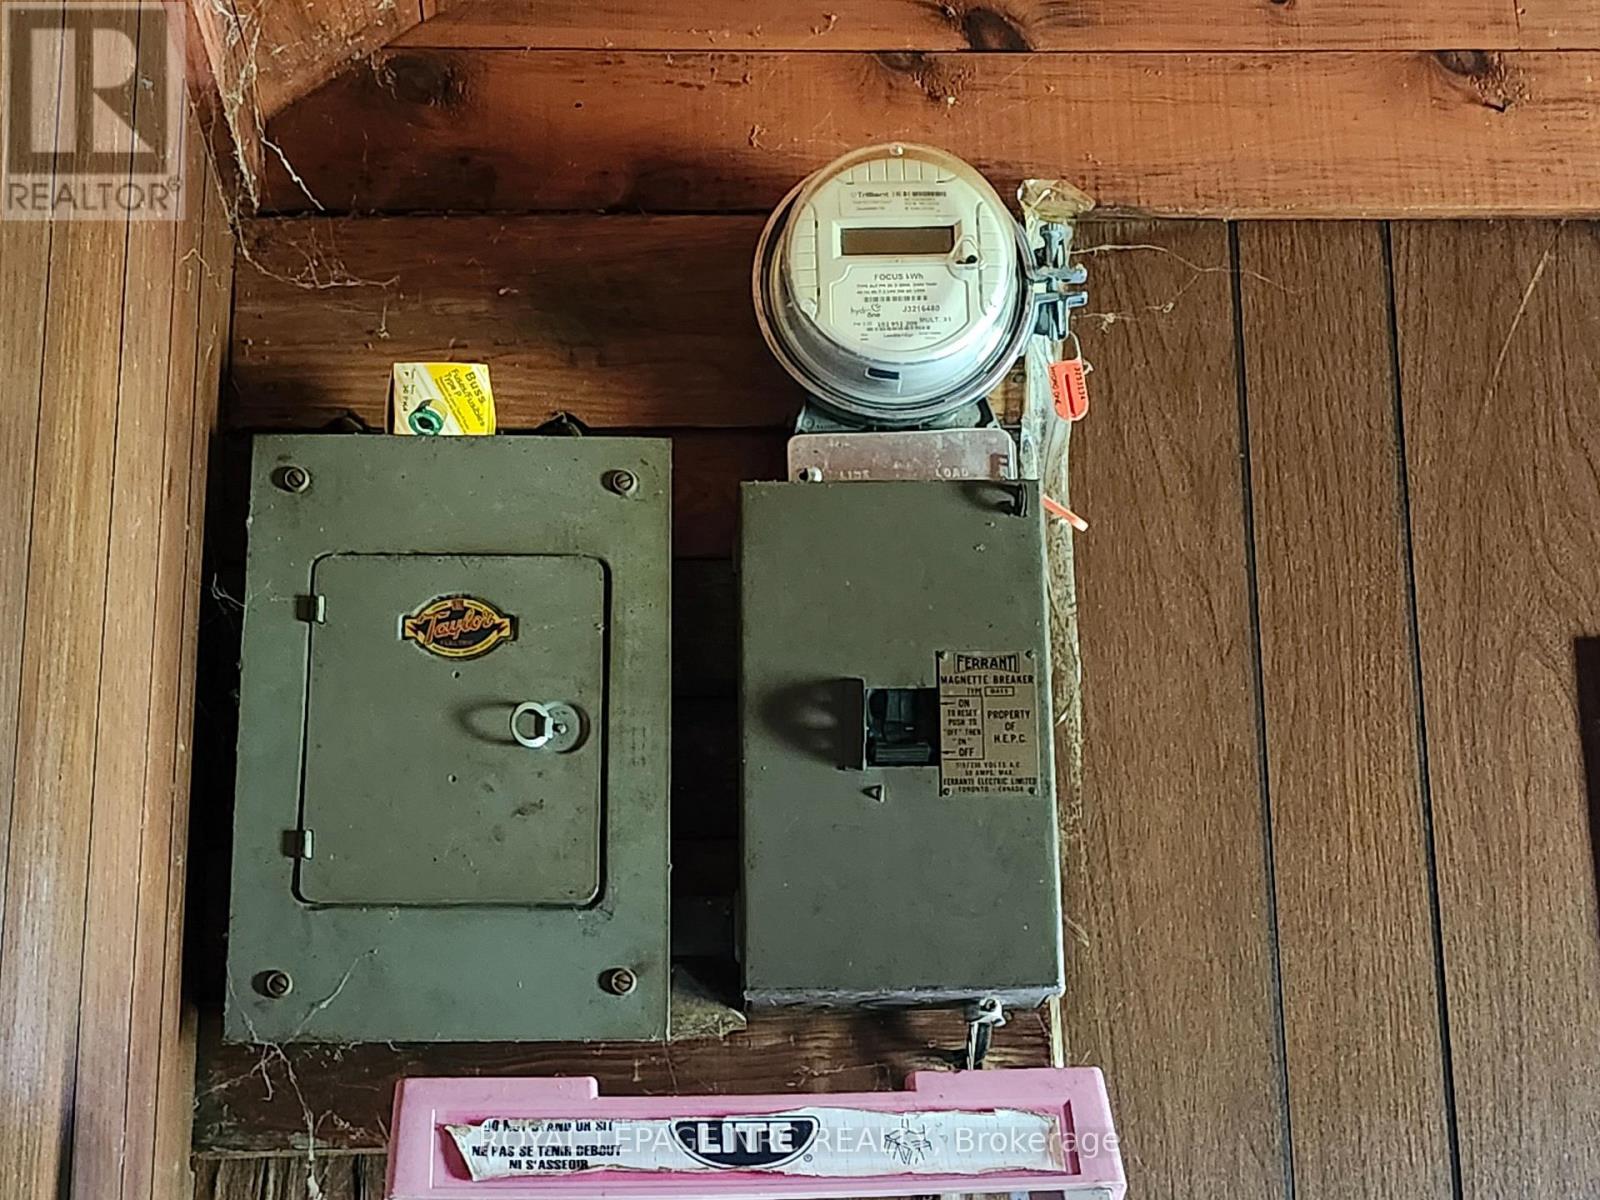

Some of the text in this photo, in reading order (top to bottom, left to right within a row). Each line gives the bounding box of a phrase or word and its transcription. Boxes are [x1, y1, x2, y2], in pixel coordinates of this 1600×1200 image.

[874, 273, 904, 281] FOCUS
[444, 372, 457, 391] Type
[465, 371, 487, 403] Buss
[417, 607, 496, 646] Taylor
[956, 654, 1017, 673] FERRANTI
[940, 674, 1034, 684] MAGNETTE BREAKER
[958, 699, 970, 708] ON
[957, 709, 978, 717] RESET
[987, 710, 1031, 720] PROPERTY
[1004, 721, 1016, 731] OF
[958, 747, 975, 757] OFF
[943, 777, 1038, 785] FERRANTI ELECTRIC LIMITED
[697, 1122, 793, 1153] LITE
[472, 1144, 622, 1157] NE PAS SE TENIR DEBOUT
[509, 1159, 588, 1170] NI S'ASSEOIR
